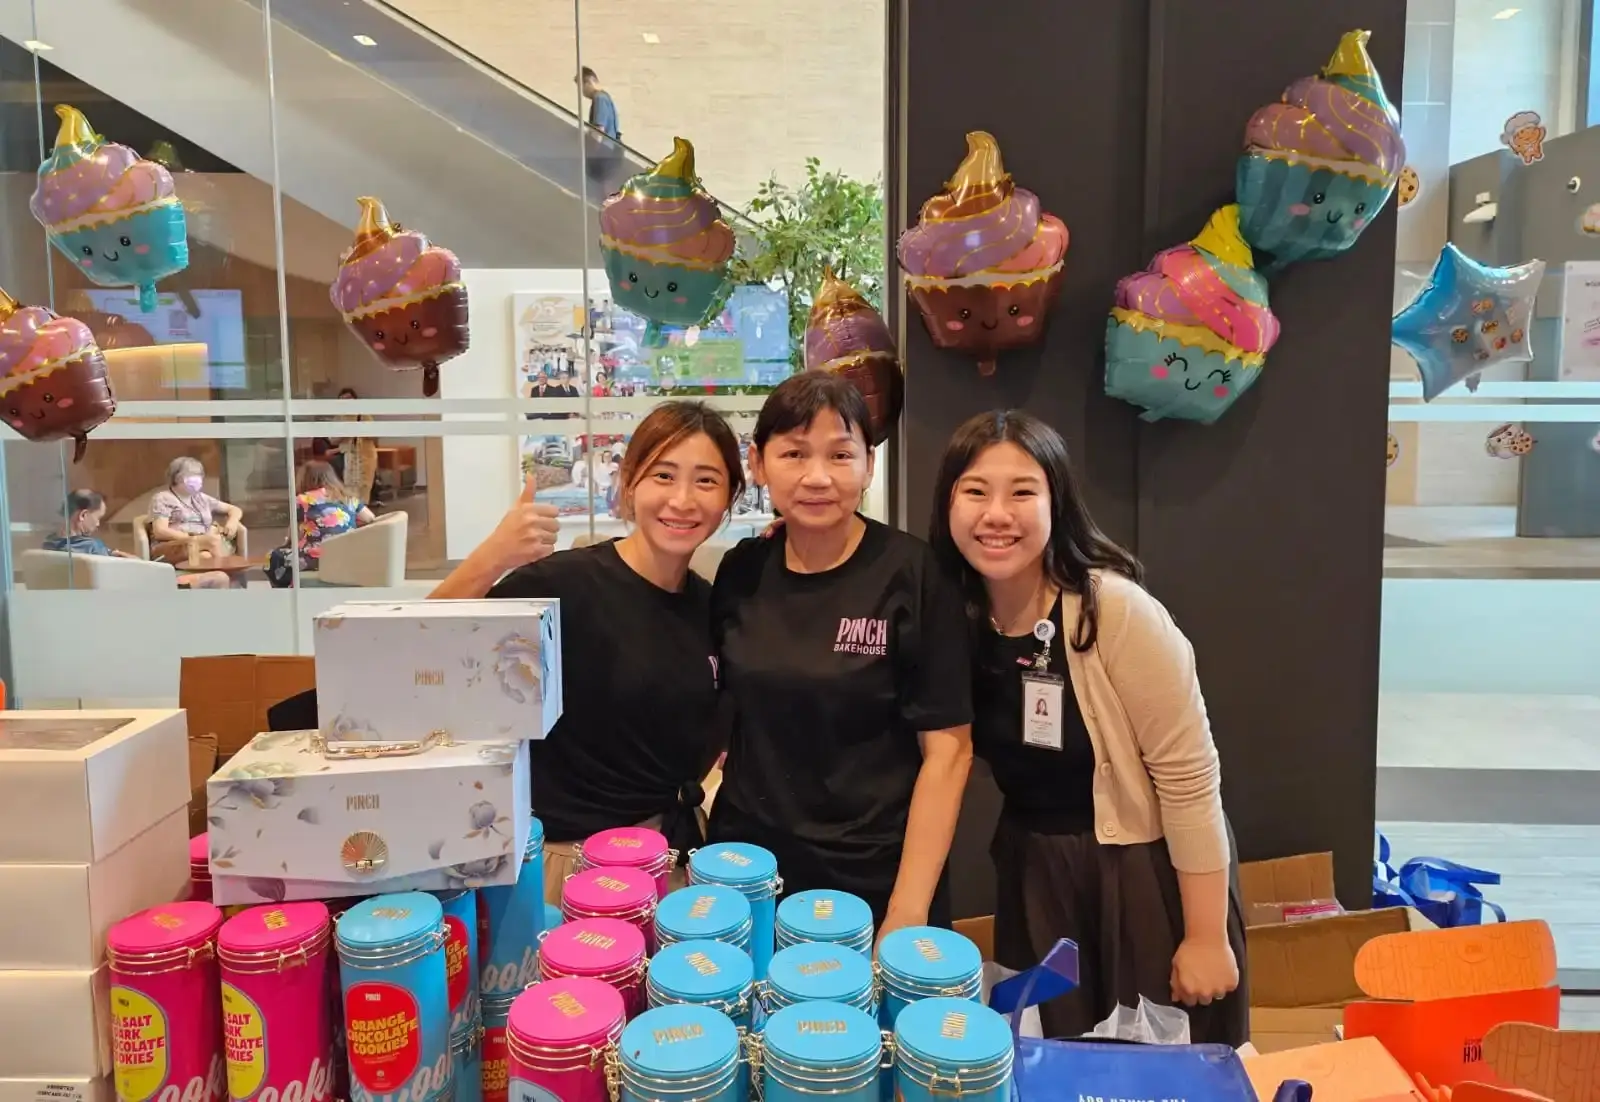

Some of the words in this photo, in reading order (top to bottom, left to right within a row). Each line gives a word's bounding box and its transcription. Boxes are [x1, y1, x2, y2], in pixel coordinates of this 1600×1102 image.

[836, 617, 888, 645] PINCH
[834, 643, 887, 656] BAKEHOUSE
[346, 794, 380, 811] PINCH
[122, 1015, 152, 1028] SALT
[347, 1018, 418, 1043] CHOCOLATE
[351, 1012, 406, 1031] ORANGE
[353, 1035, 409, 1055] COOKIES
